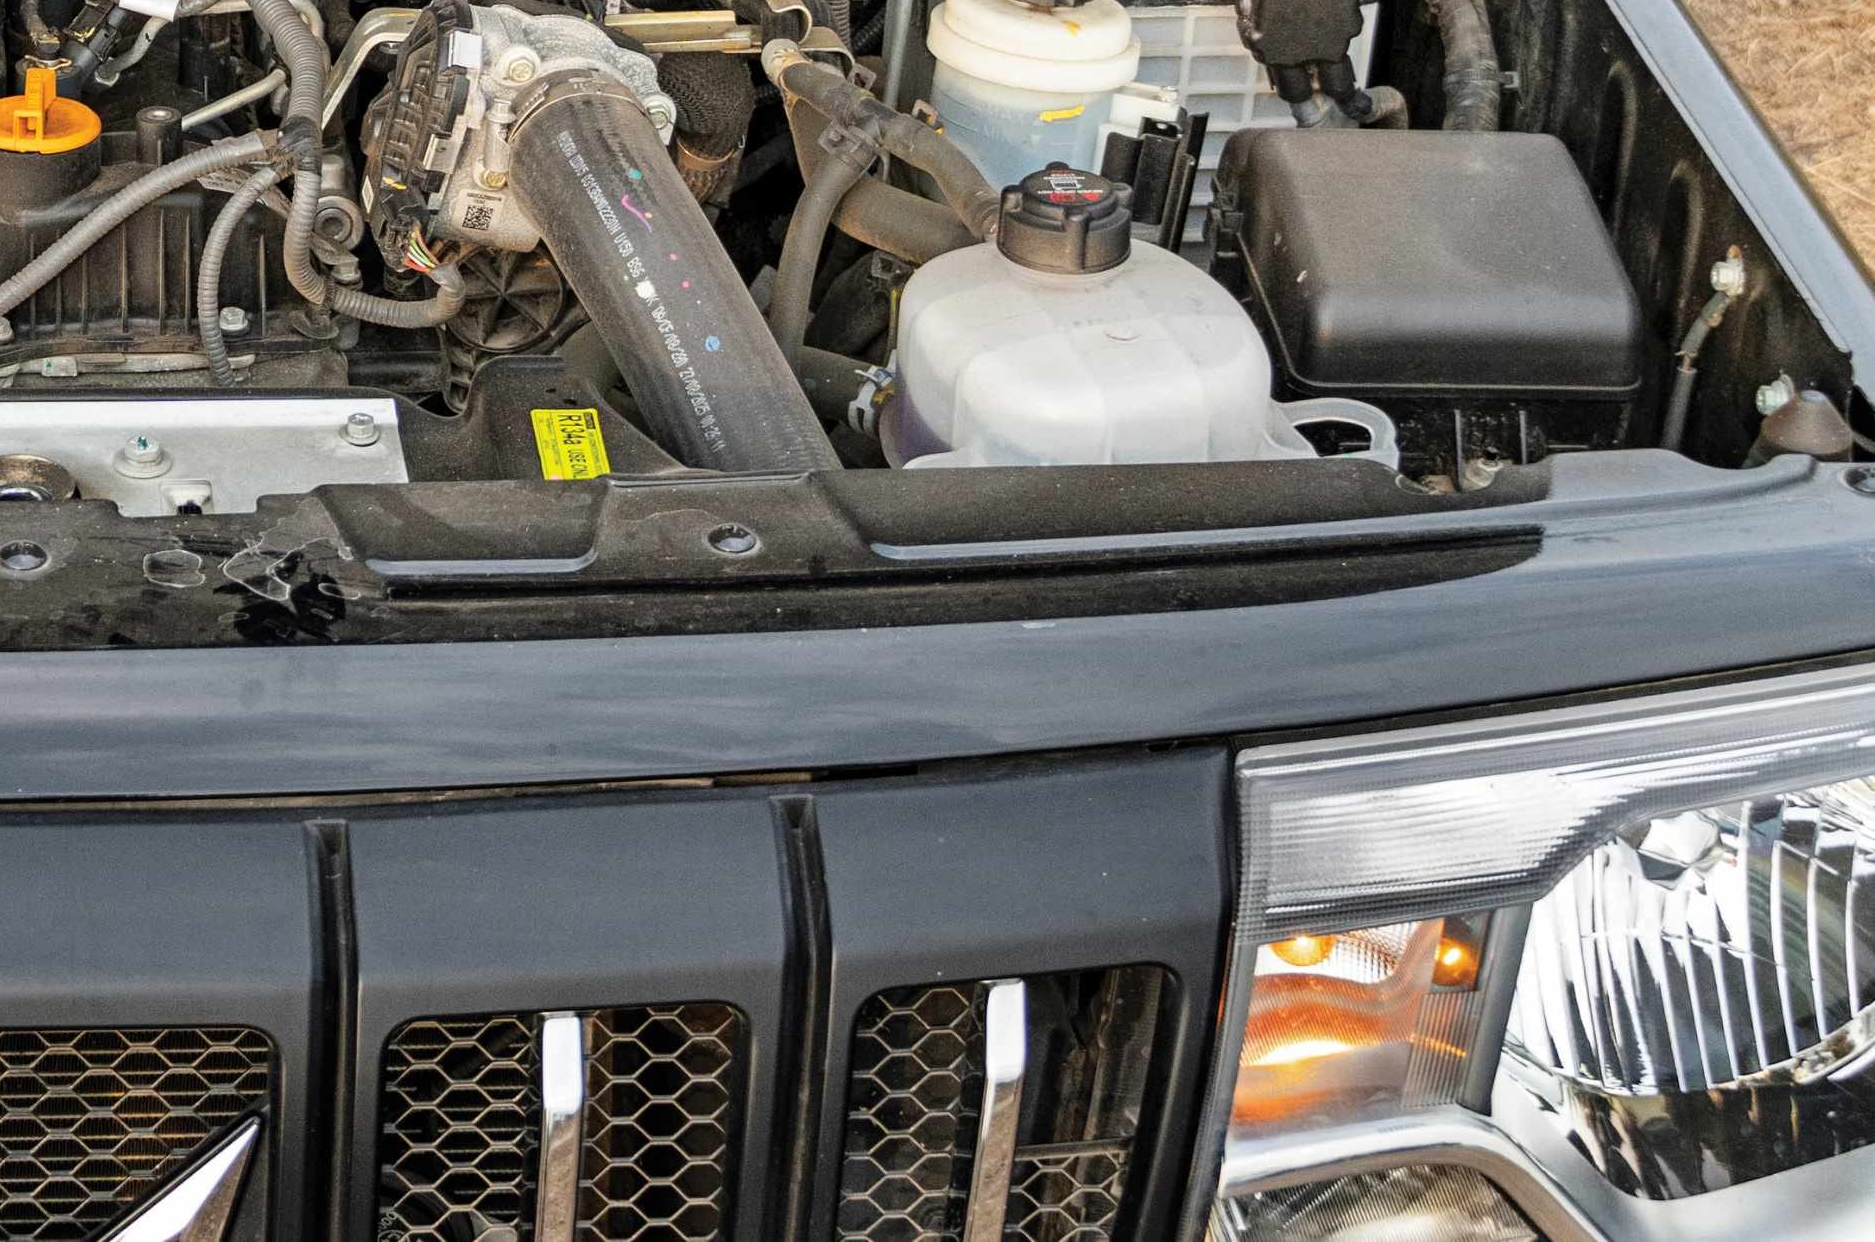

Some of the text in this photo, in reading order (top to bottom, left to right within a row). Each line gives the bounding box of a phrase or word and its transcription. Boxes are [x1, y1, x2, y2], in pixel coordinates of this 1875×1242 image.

[613, 232, 634, 258] U150
[627, 256, 645, 278] BS6
[557, 414, 587, 445] R134a
[571, 463, 589, 478] ONL
